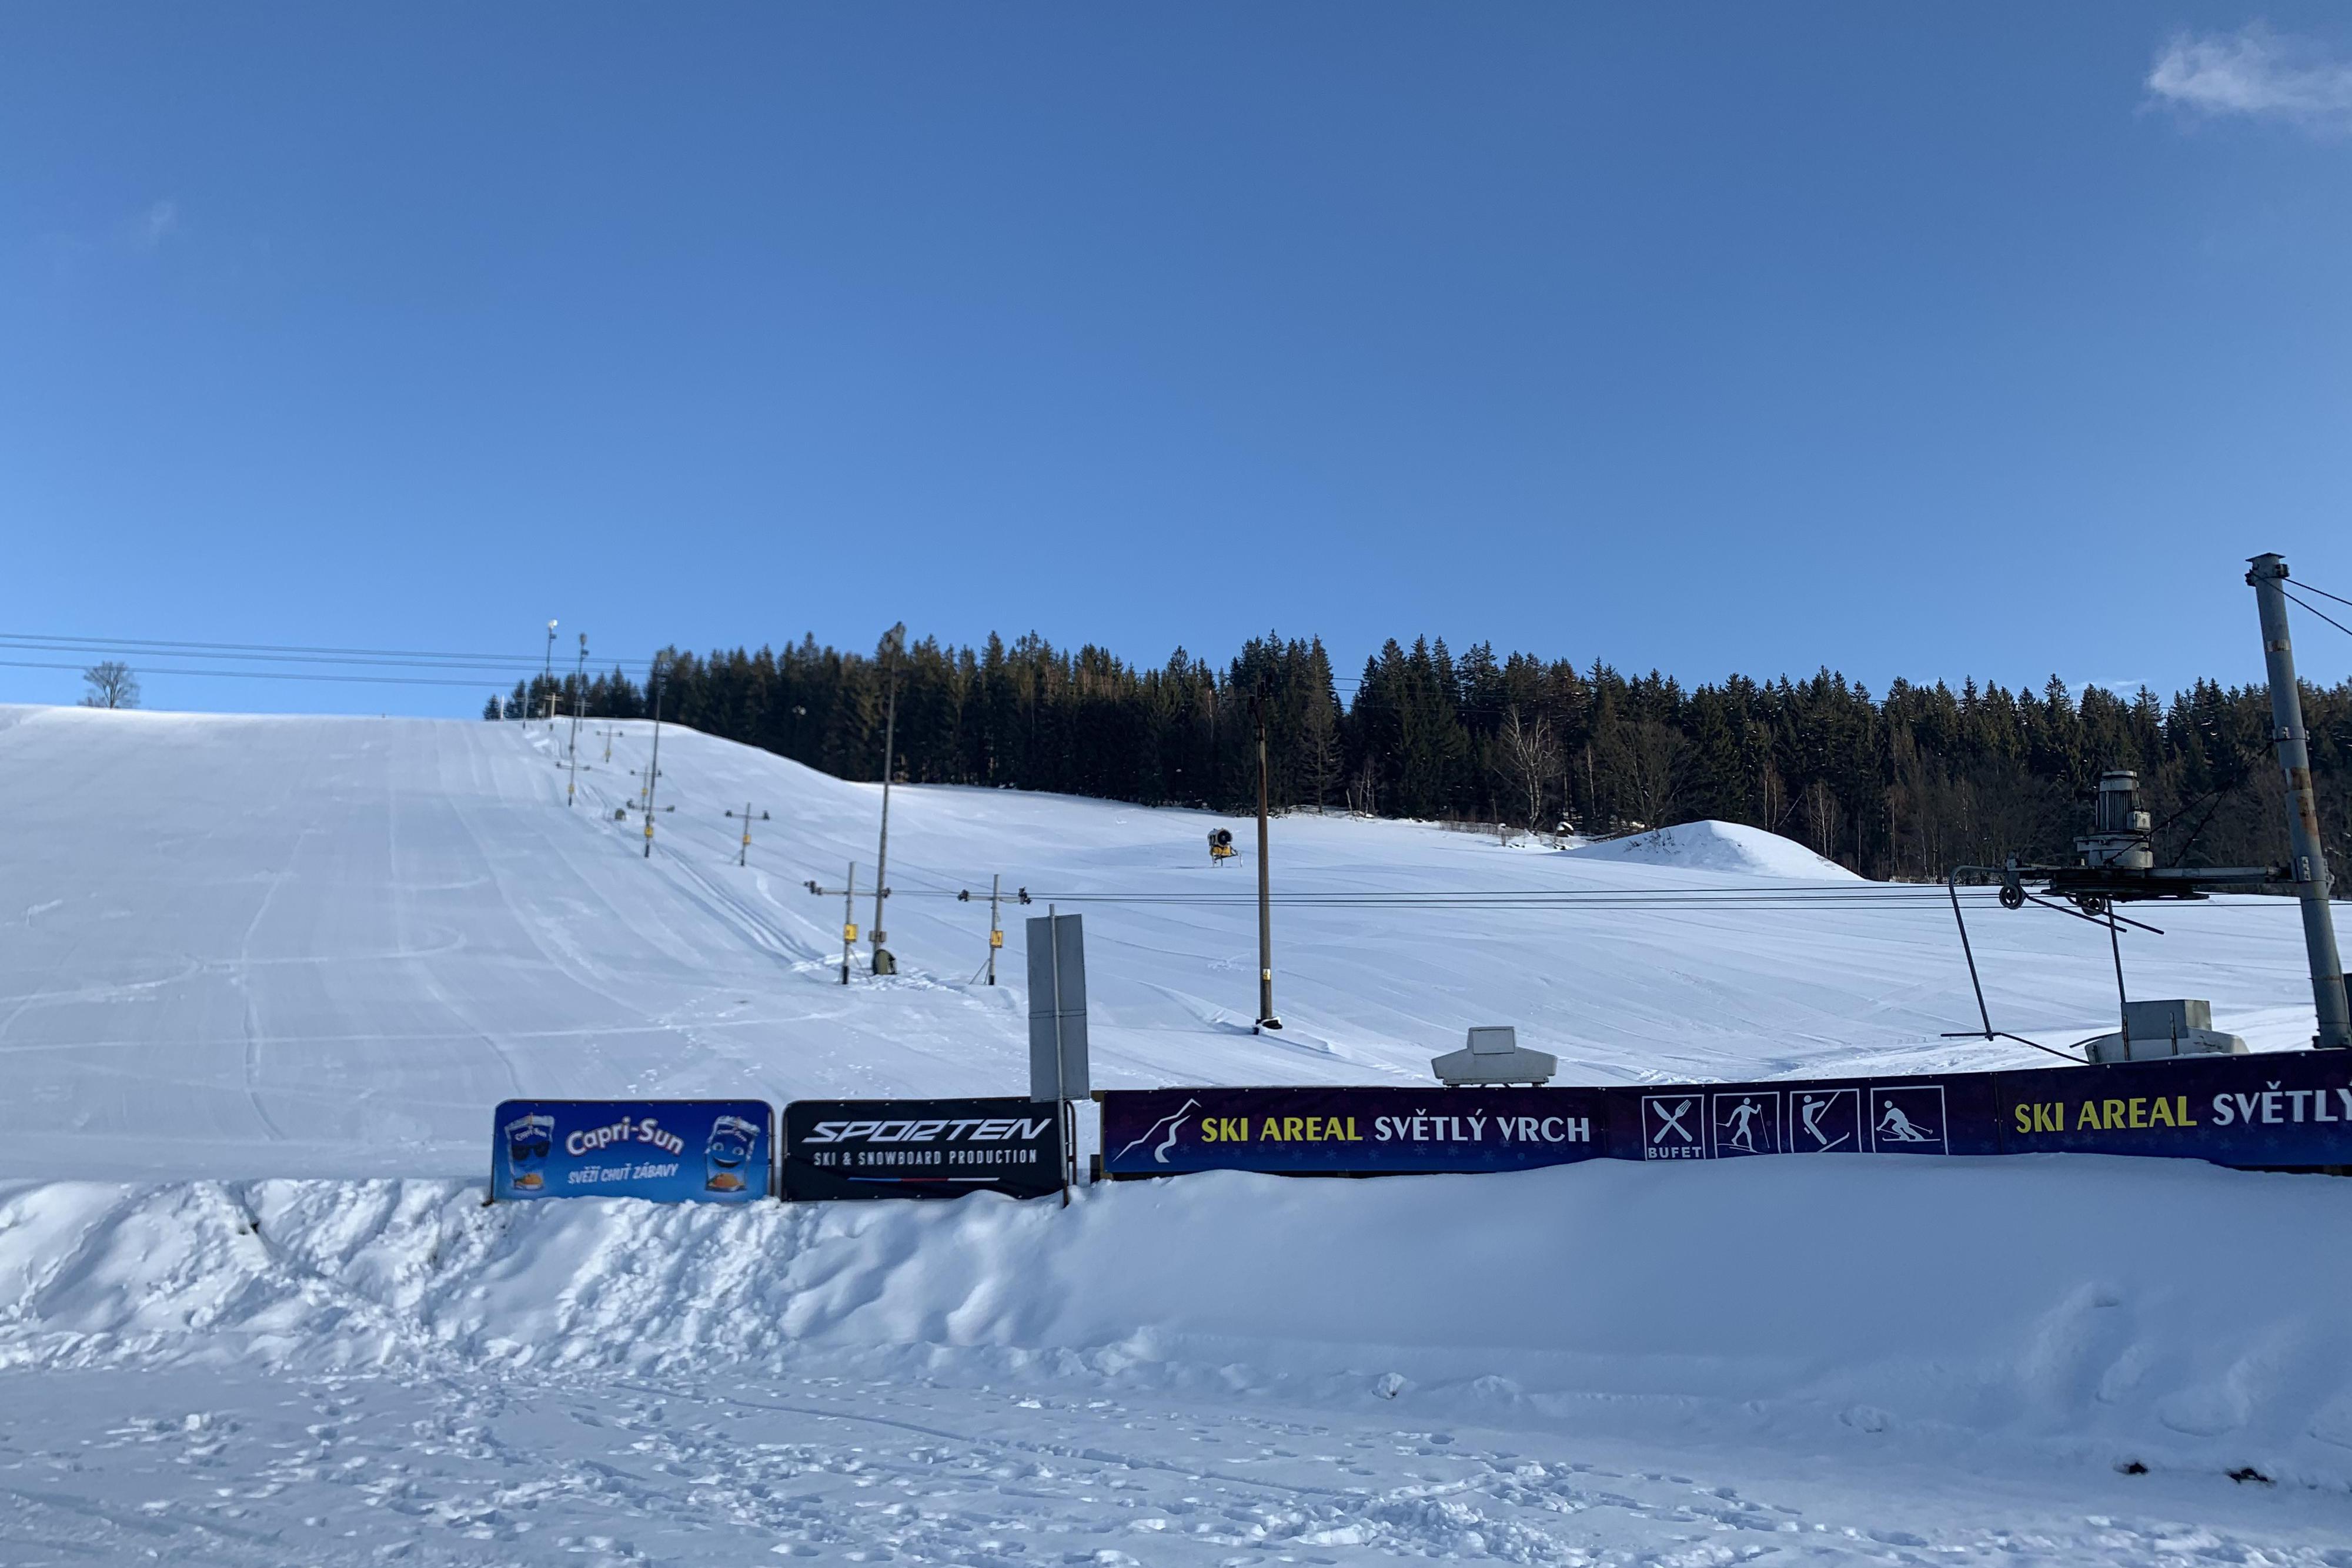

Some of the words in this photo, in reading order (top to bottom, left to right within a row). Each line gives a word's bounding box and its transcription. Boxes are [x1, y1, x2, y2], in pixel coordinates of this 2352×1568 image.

[1201, 1118, 1248, 1142] SKI
[1259, 1116, 1363, 1141] AREAL
[1375, 1108, 1487, 1142] SVĚTLÝ
[1496, 1116, 1590, 1142] VRCH
[2015, 1102, 2064, 1134] SKI
[2077, 1096, 2197, 1131] AREAL
[566, 1116, 684, 1156] Capri-Sun
[801, 1118, 1052, 1143] SPORTEN
[814, 1152, 836, 1166] SKI
[842, 1152, 851, 1166] &
[858, 1151, 941, 1165] SNOWBOARD
[948, 1149, 1037, 1165] PRODUCTION
[1648, 1146, 1702, 1158] BUFET
[600, 1162, 632, 1182] CHUŤ
[632, 1161, 679, 1179] ZÁBAVY
